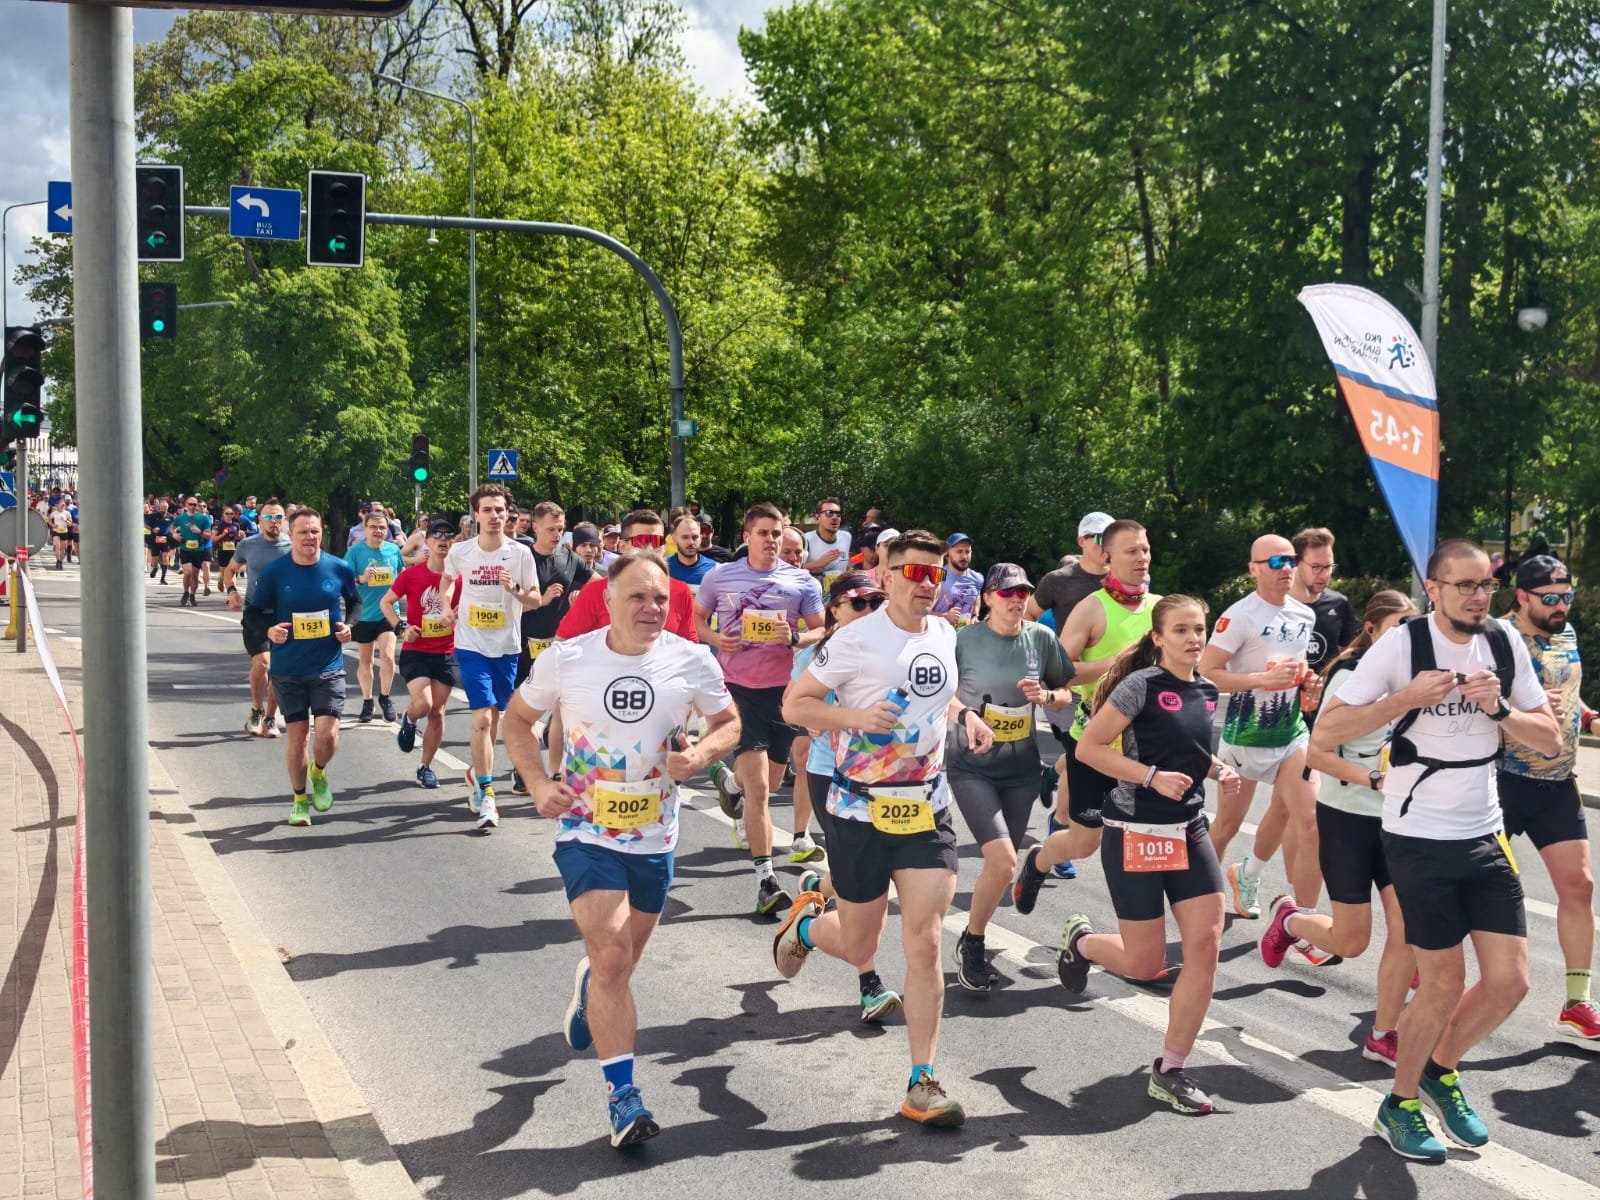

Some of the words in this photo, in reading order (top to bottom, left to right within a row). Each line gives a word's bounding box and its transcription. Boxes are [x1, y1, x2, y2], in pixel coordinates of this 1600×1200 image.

[256, 221, 272, 229] BUS
[256, 228, 273, 236] TAXI
[476, 611, 499, 620] 1904
[300, 620, 323, 631] 1531
[993, 719, 1024, 730] 2260
[608, 798, 649, 813] 2002
[881, 804, 919, 818] 2023
[1137, 841, 1174, 856] 1018
